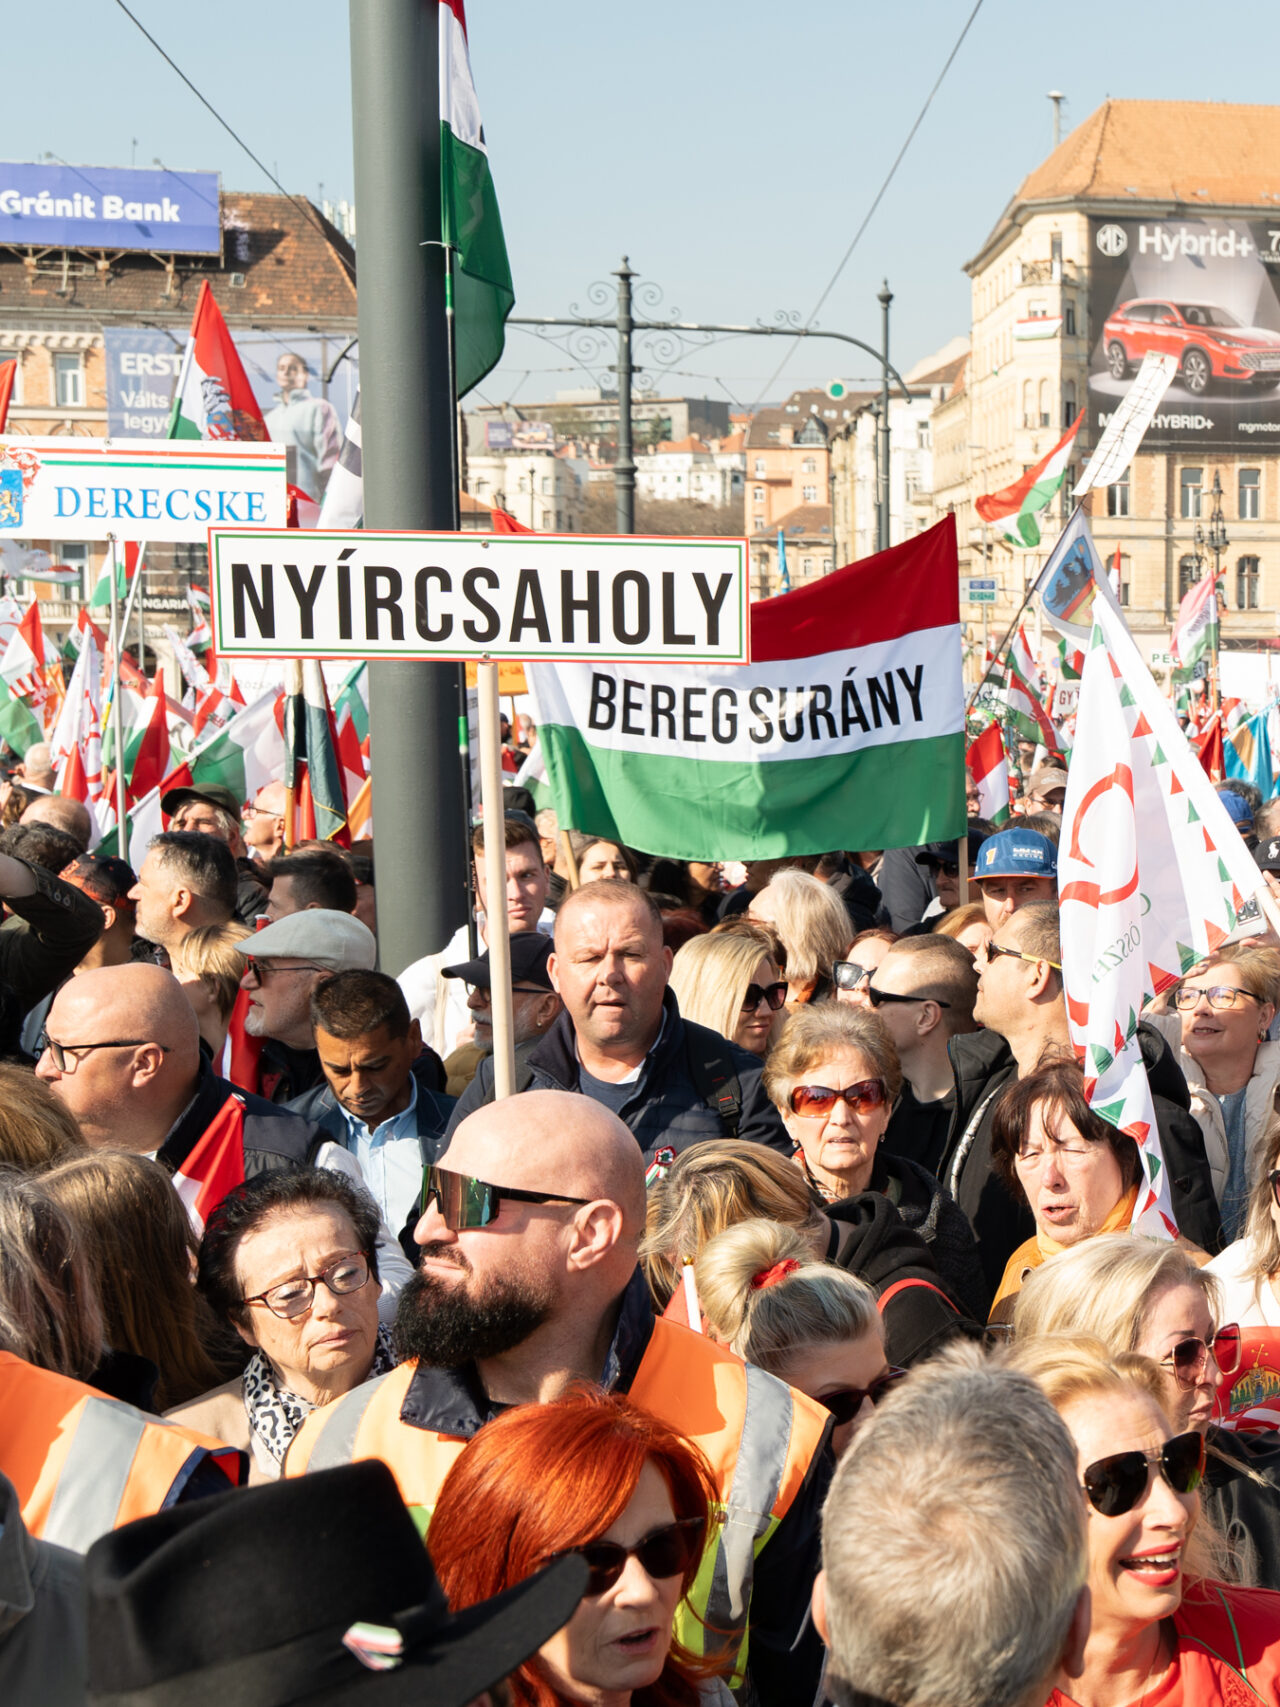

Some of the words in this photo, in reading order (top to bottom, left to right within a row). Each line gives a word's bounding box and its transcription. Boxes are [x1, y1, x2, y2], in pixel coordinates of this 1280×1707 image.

[0, 190, 95, 218] Gránit
[103, 195, 180, 222] Bank
[1139, 225, 1253, 261] Hybrid+
[120, 353, 183, 376] ERST
[1150, 414, 1214, 430] HYBRID+
[54, 486, 268, 523] DERECSKE
[231, 548, 733, 646] NYÍRCSAHOLY
